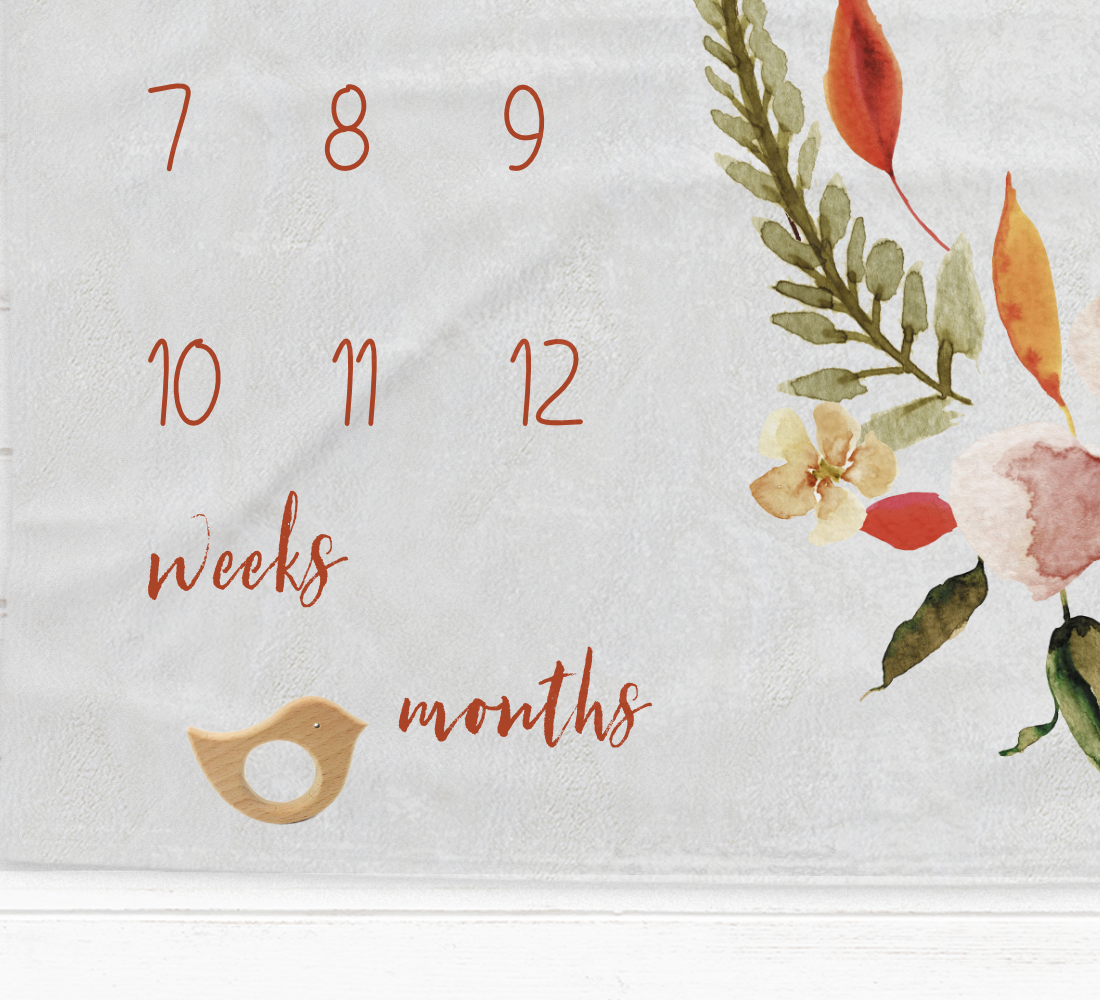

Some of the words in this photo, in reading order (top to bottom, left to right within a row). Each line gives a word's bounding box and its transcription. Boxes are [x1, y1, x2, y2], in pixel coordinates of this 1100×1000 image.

[147, 82, 192, 172] 7
[324, 83, 370, 172] 8
[503, 84, 545, 172] 9
[147, 338, 221, 427] 10
[331, 338, 378, 427] 11
[510, 338, 584, 427] 12
[147, 490, 349, 608] weeks
[398, 646, 653, 748] months
